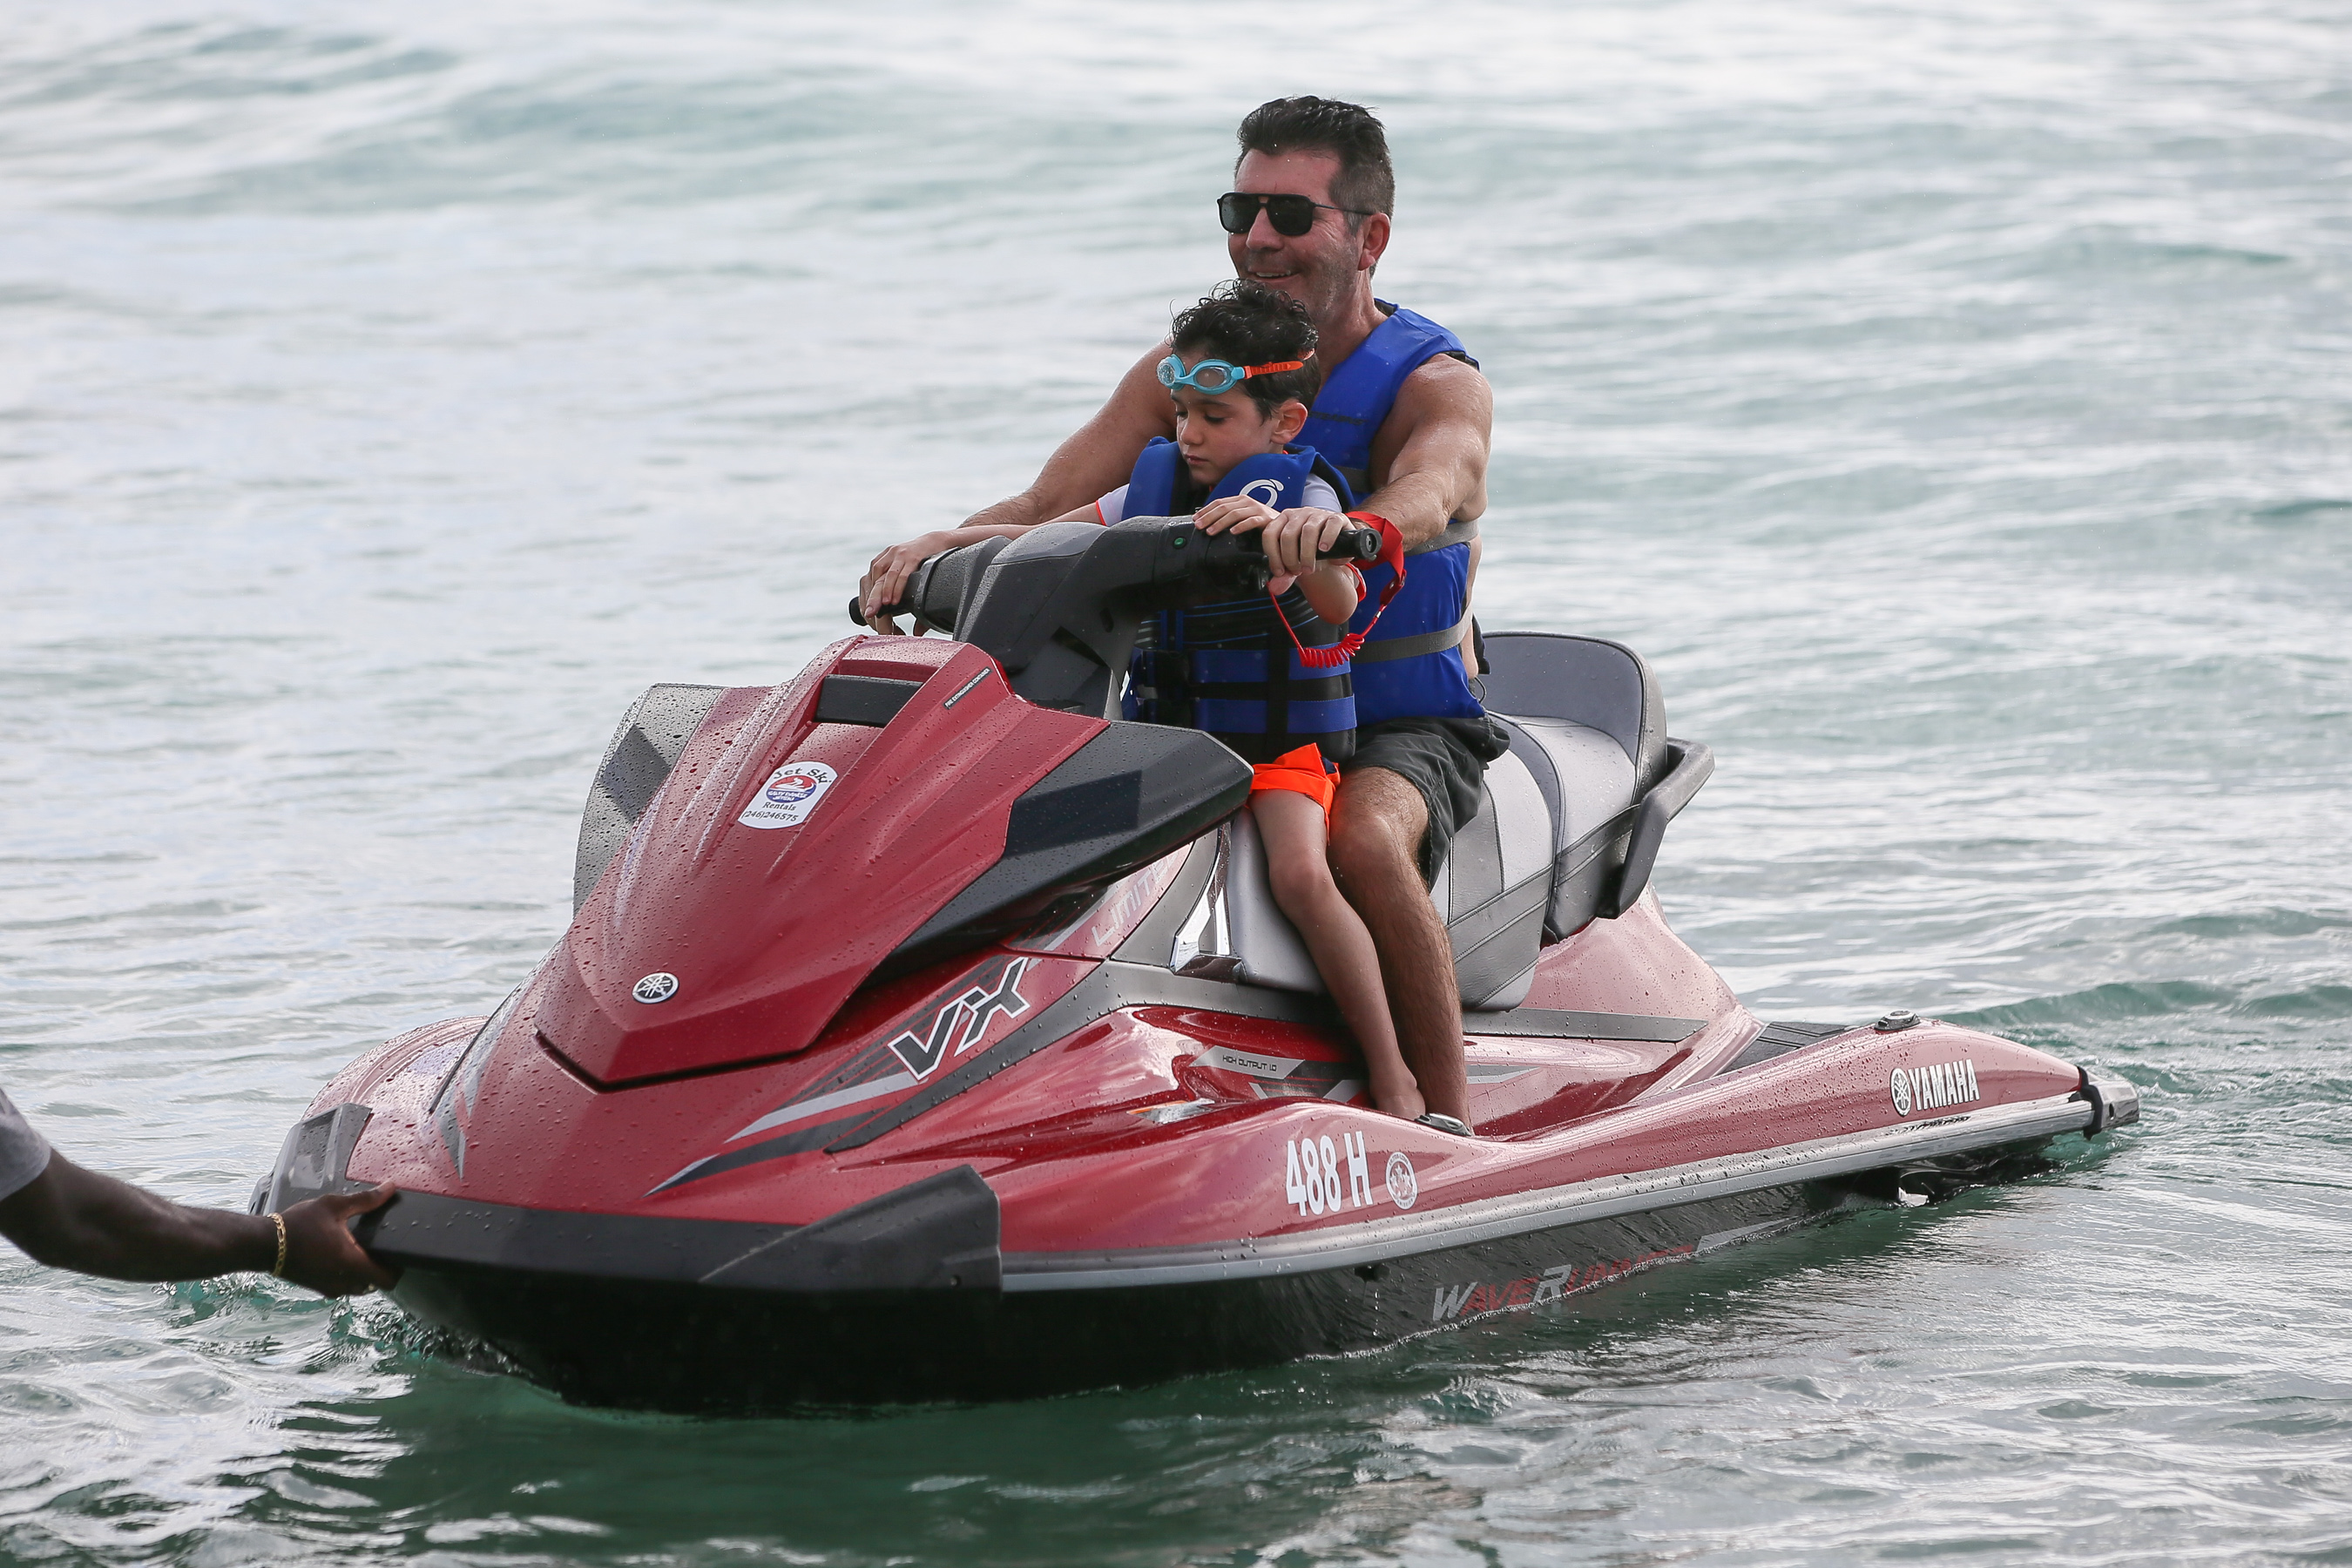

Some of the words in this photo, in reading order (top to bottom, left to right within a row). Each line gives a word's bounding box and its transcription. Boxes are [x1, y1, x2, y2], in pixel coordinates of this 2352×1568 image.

[774, 767, 802, 780] Jet
[807, 768, 832, 784] Ski
[762, 801, 796, 811] Rentals
[741, 810, 799, 821] (246)246575
[888, 956, 1031, 1081] VX
[1238, 1058, 1267, 1070] OUTPUT
[1908, 1058, 1981, 1111] YAMAHA
[1286, 1135, 1342, 1217] 488
[1344, 1131, 1374, 1208] H
